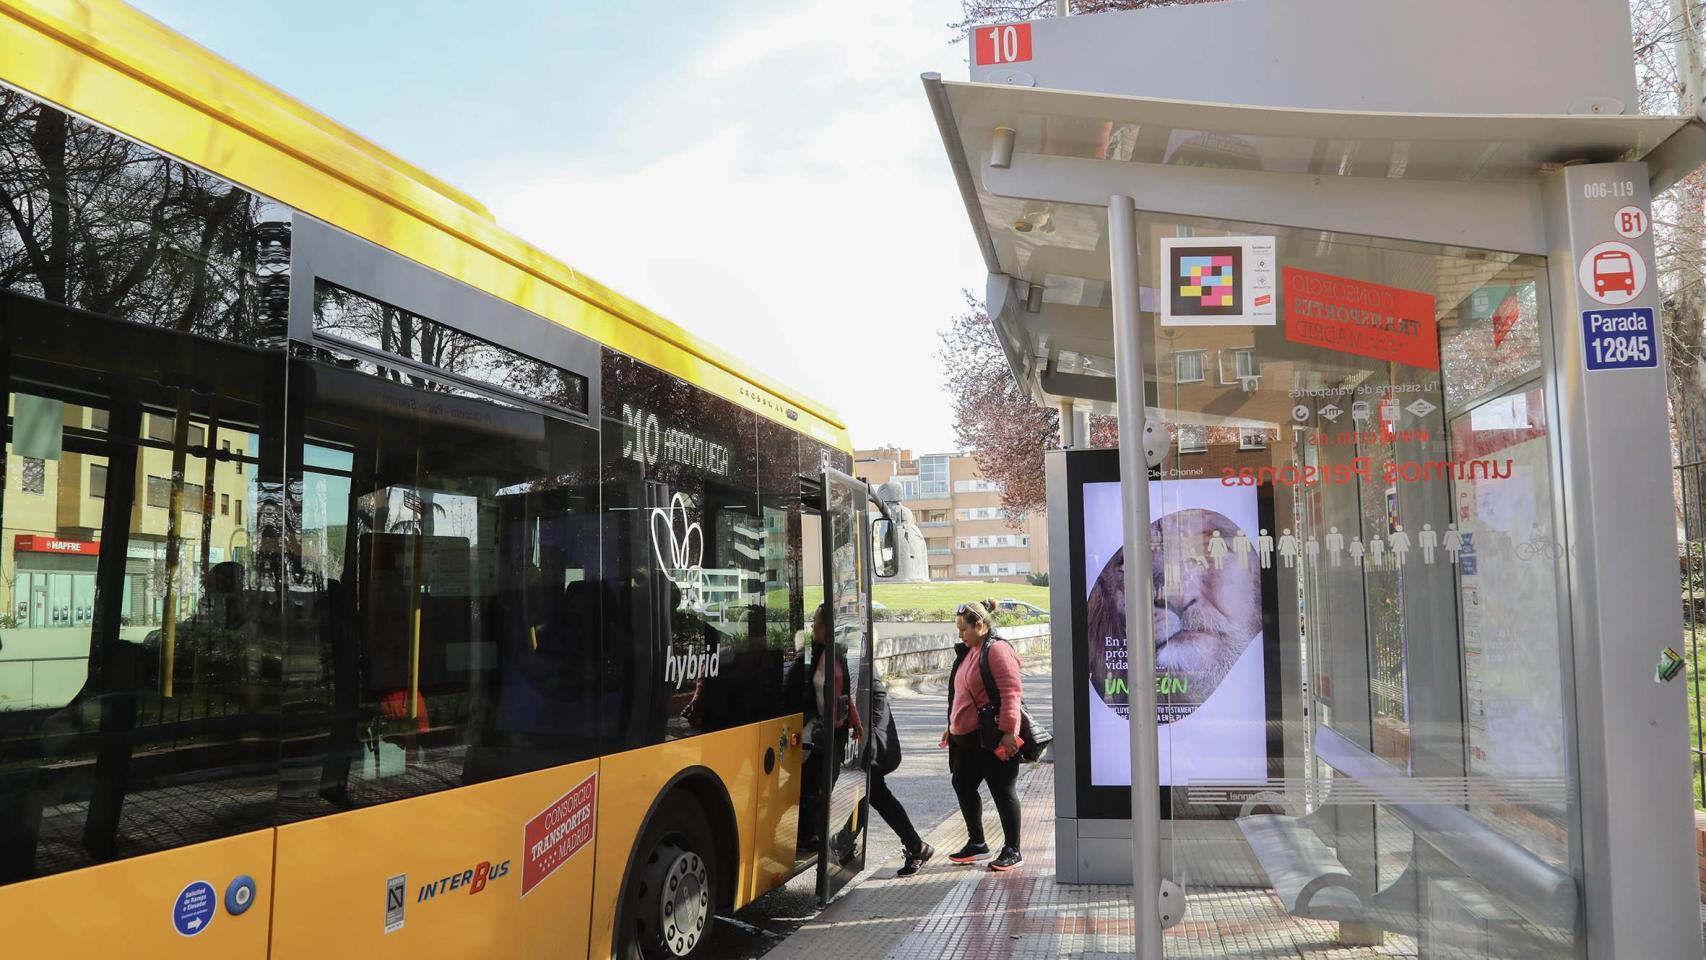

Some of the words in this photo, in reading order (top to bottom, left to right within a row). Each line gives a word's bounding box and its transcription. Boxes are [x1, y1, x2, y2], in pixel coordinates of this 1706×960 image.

[990, 26, 1018, 63] 10
[1584, 181, 1634, 198] 006-119
[1621, 212, 1641, 233] B1
[1590, 312, 1647, 332] Parada
[1592, 336, 1650, 363] 12845
[1170, 468, 1203, 476] Channel
[51, 540, 81, 551] MAPFRE
[1105, 636, 1120, 646] En
[665, 643, 720, 690] hybrid
[544, 783, 592, 830] CONSORCIO
[531, 803, 591, 862] TRANSPORTES
[559, 823, 590, 860] MADRID
